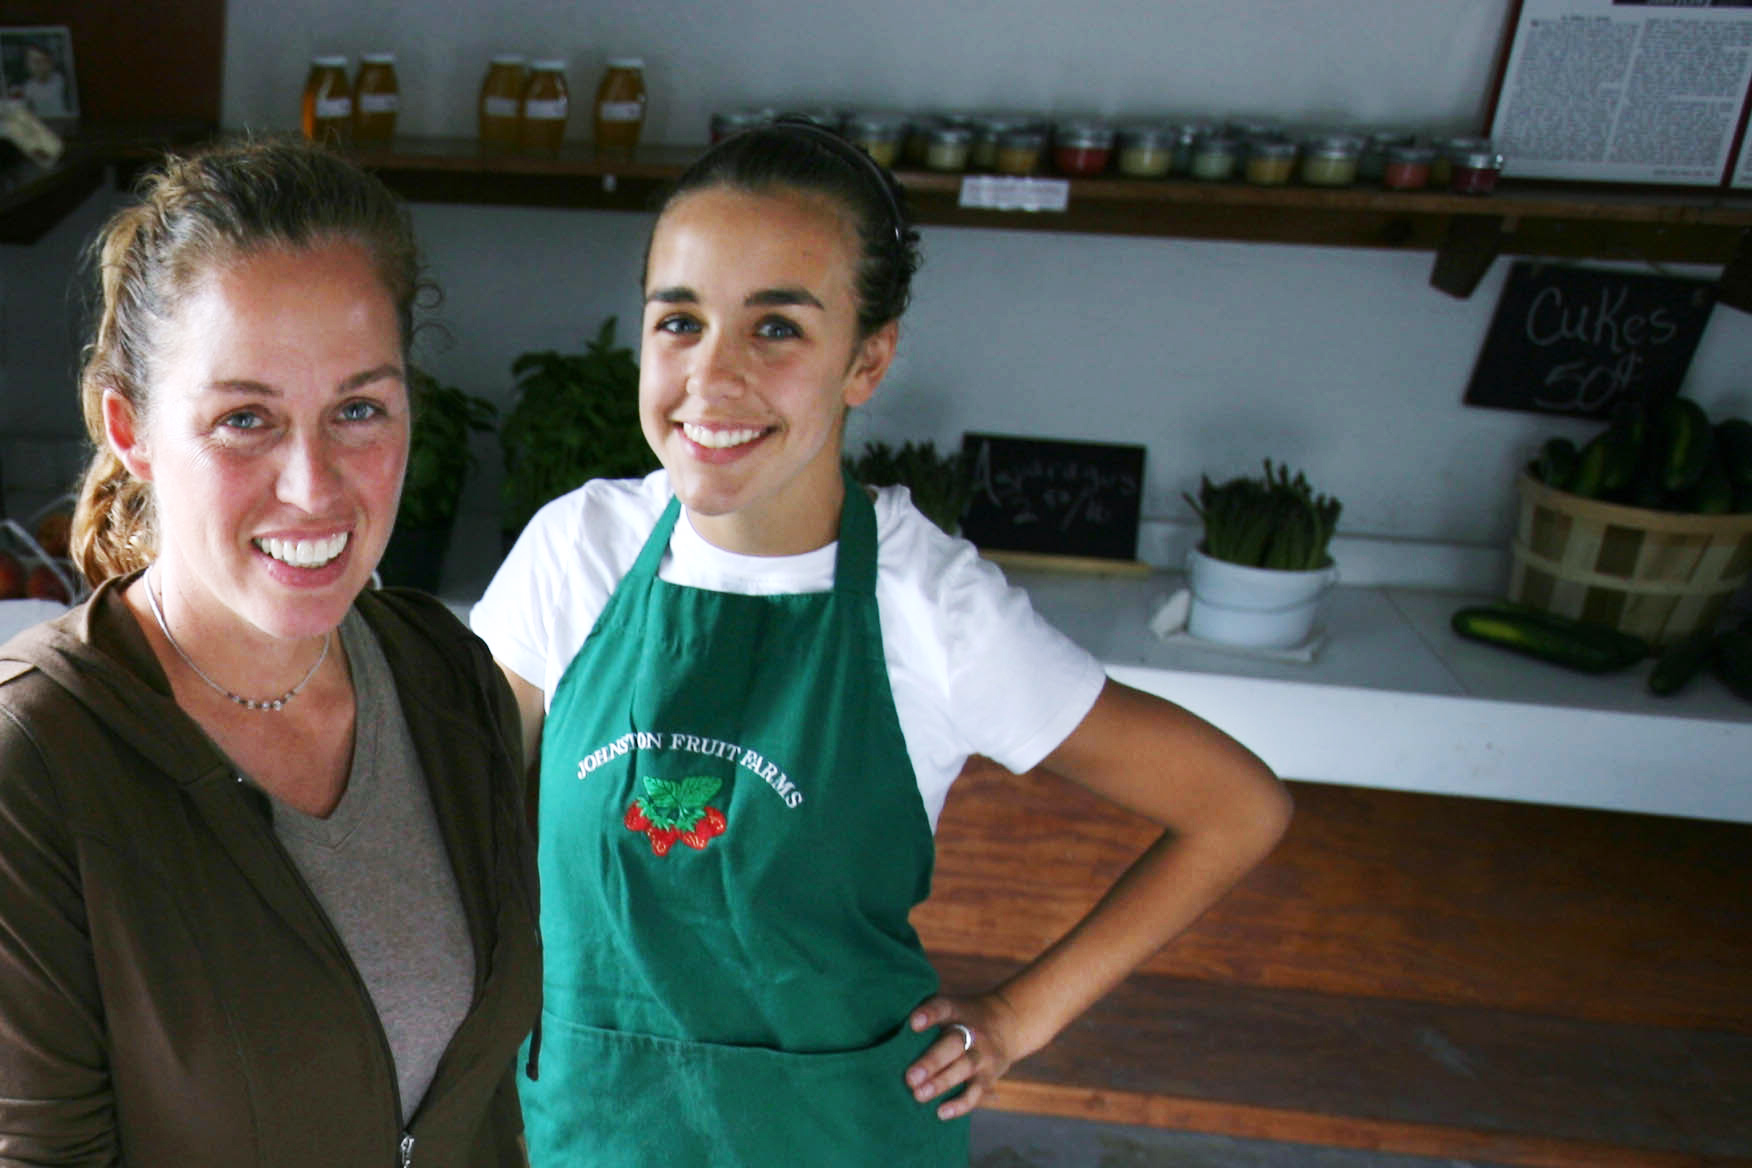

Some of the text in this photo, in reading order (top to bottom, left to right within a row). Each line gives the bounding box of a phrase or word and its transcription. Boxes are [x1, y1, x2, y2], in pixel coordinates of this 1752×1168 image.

[1527, 284, 1676, 353] Cukes
[577, 731, 803, 808] JOHNSTON FRUIT FARMS
